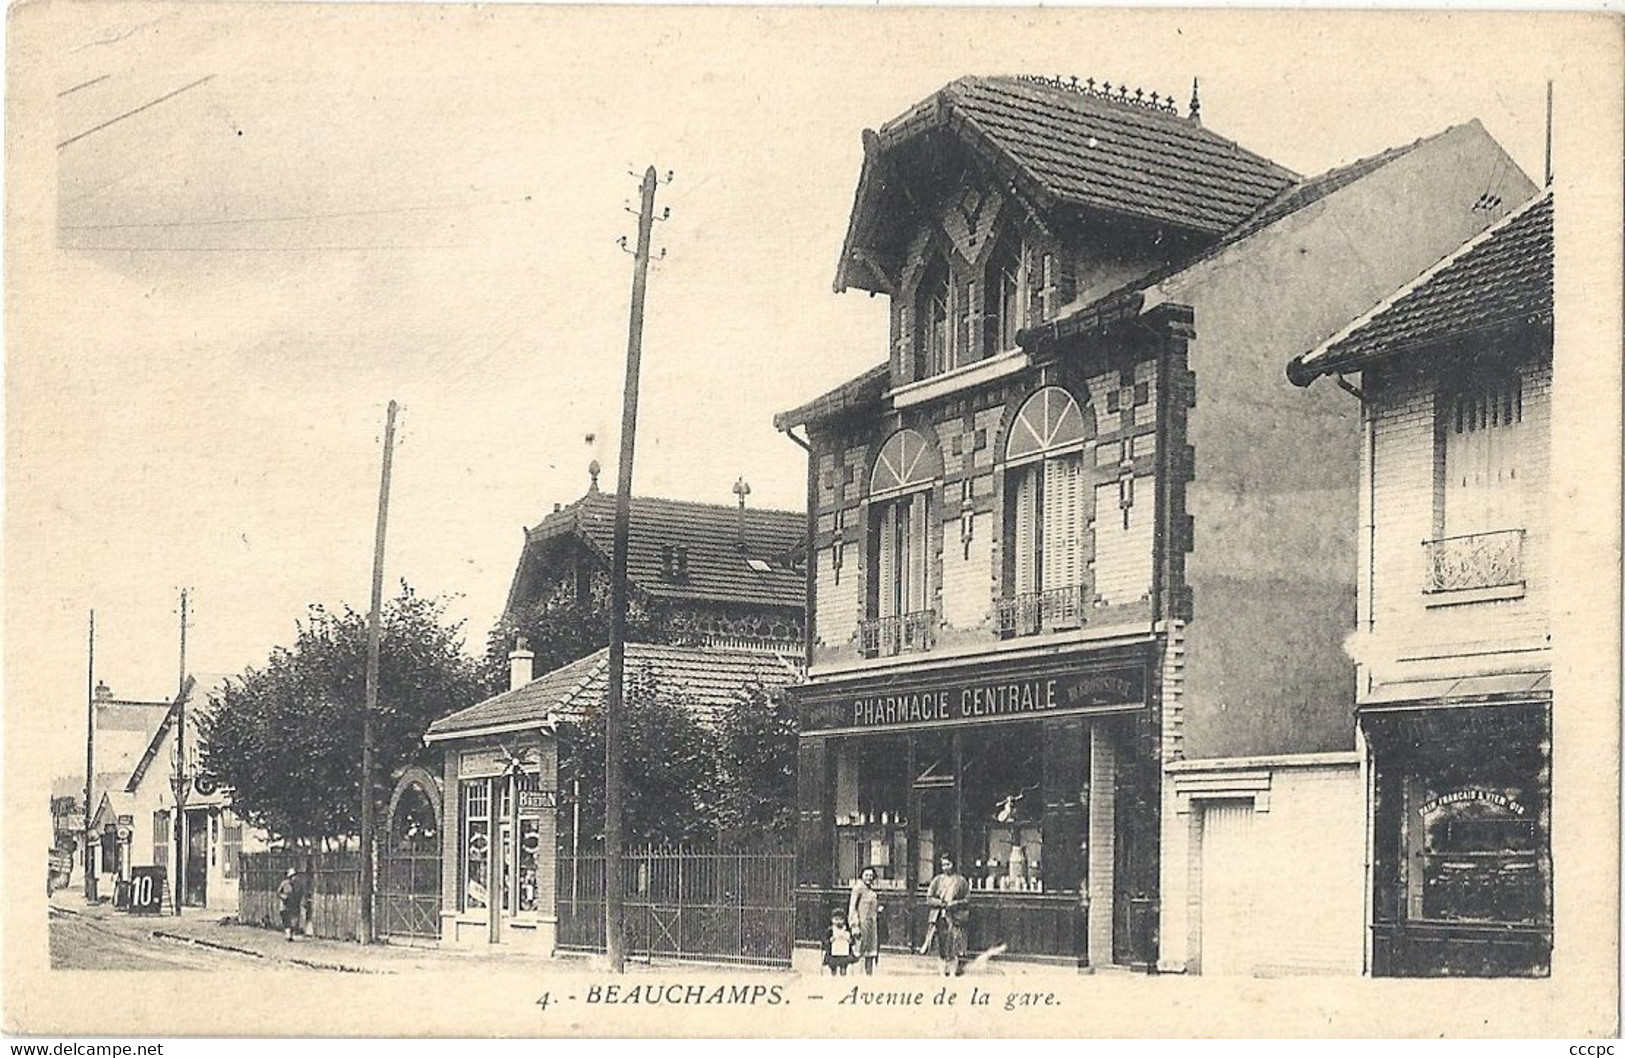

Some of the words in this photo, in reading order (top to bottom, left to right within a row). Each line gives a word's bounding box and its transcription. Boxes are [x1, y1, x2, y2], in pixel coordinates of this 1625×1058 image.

[853, 692, 950, 726] PHARMACIE
[961, 680, 1058, 716] CENTRALE
[1438, 790, 1477, 806] FRANÇAIS
